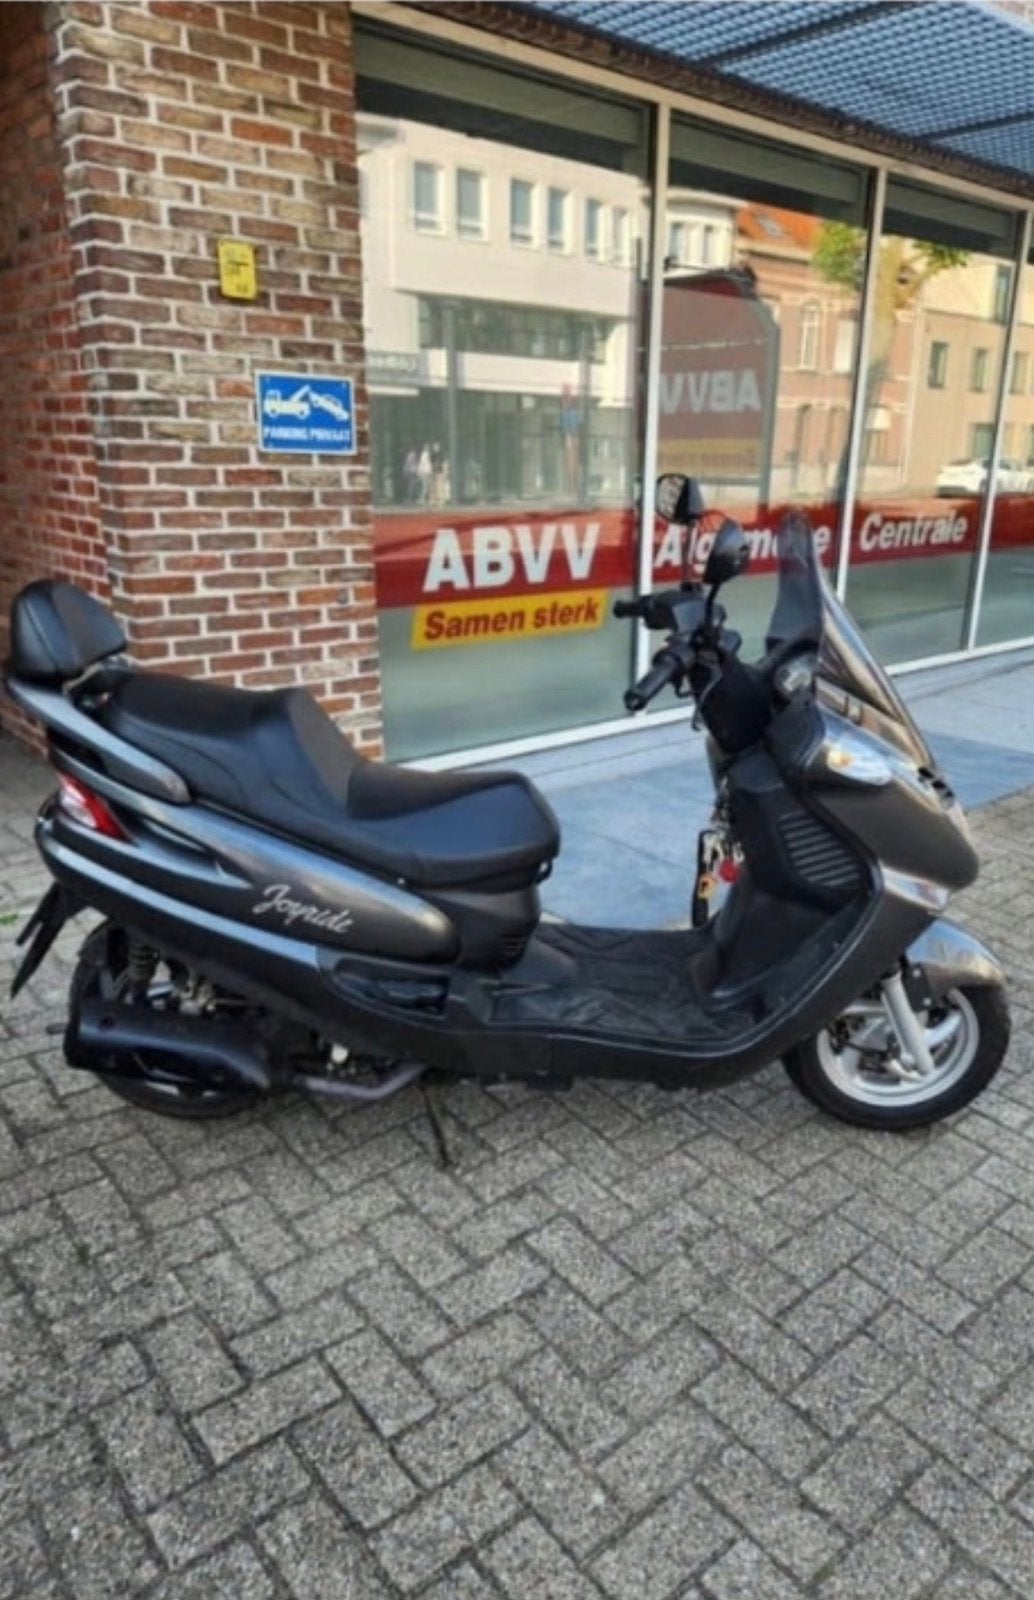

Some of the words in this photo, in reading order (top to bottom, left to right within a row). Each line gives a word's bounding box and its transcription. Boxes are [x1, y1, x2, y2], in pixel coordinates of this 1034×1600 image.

[422, 522, 601, 592] ABVV
[859, 509, 969, 552] Centrale
[424, 609, 525, 641] Samen
[533, 597, 600, 629] sterk
[251, 884, 354, 933] Joyride
